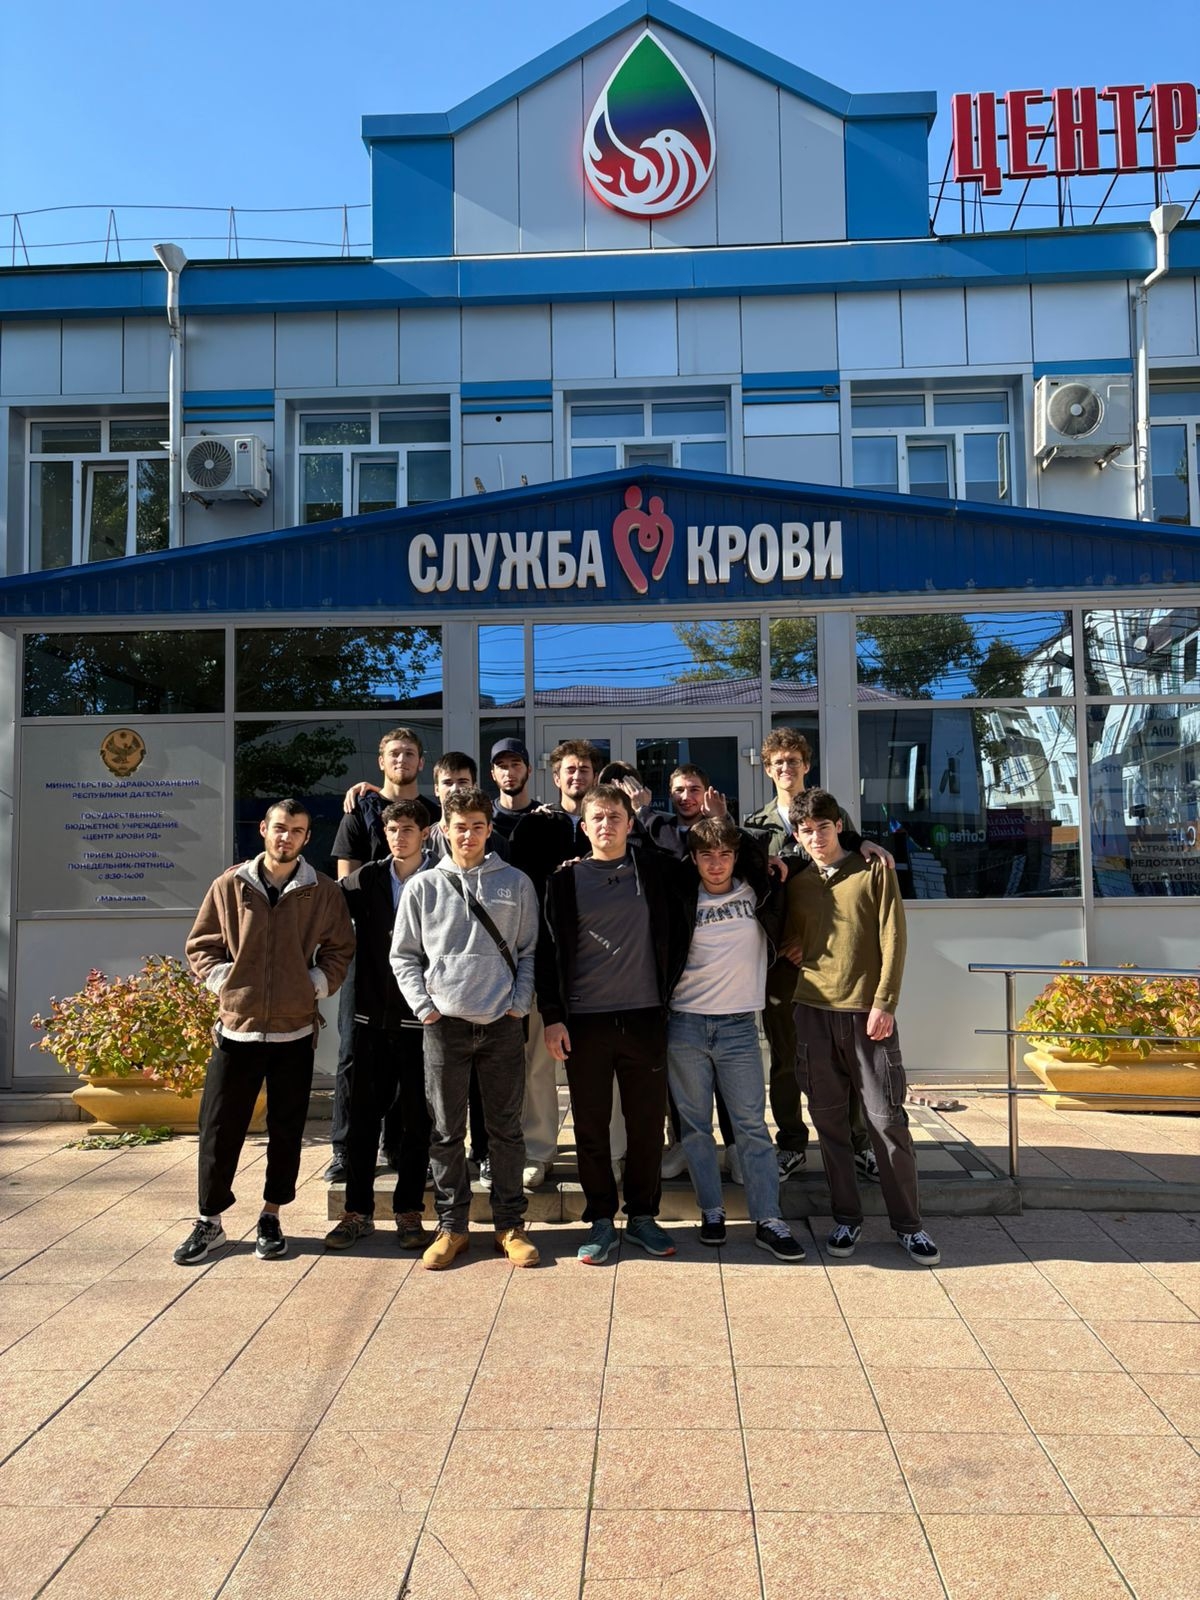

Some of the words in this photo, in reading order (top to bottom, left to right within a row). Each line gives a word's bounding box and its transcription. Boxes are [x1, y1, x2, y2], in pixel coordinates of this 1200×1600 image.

[952, 82, 1198, 196] ЦЕНТР
[408, 529, 606, 593] СЛУЖБА
[687, 521, 843, 584] КРОВИ
[72, 791, 128, 799] РЕСПУБЛИКИ
